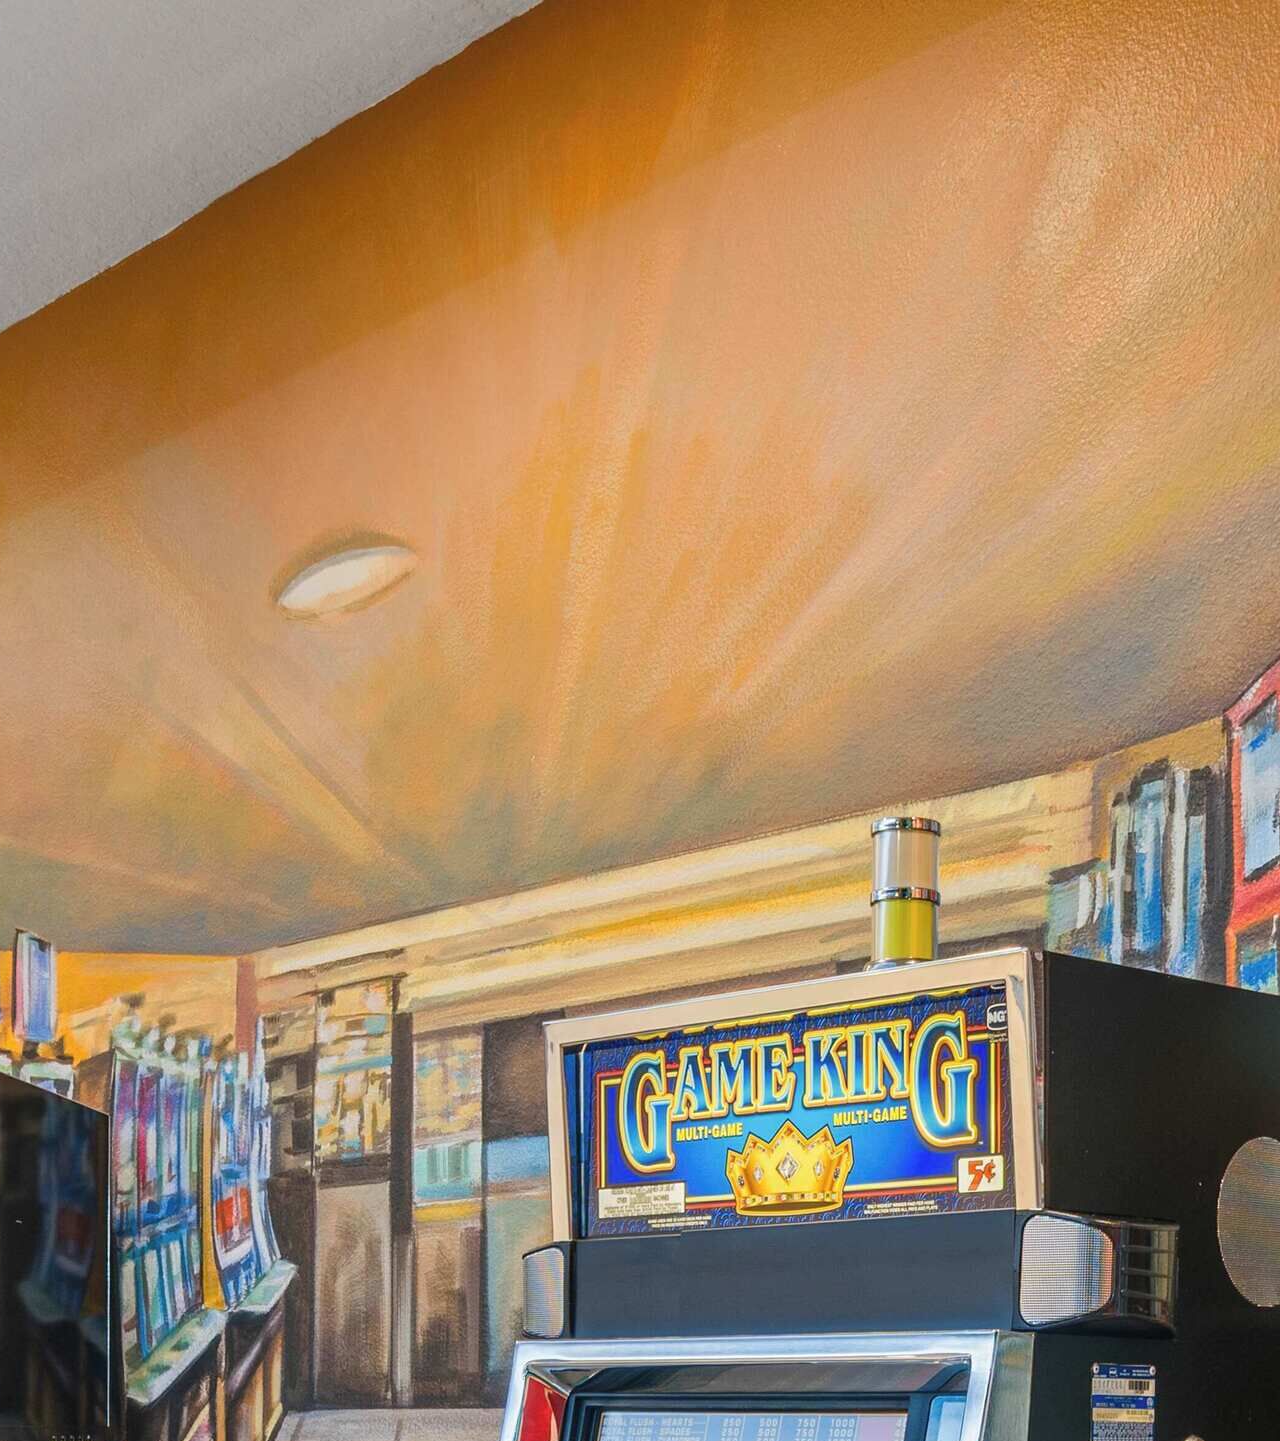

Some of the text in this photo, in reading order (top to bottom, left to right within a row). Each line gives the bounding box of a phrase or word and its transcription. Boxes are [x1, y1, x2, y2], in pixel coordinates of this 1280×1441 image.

[618, 1010, 978, 1173] GAME KING
[833, 1105, 908, 1127] MULTI-GAME
[676, 1123, 743, 1142] MULTI-GAME
[967, 1160, 997, 1191] 5¢
[757, 1428, 776, 1437] 500
[795, 1429, 814, 1437] 750
[829, 1429, 853, 1437] 1000
[759, 1418, 778, 1427] 500
[831, 1418, 855, 1427] 1000
